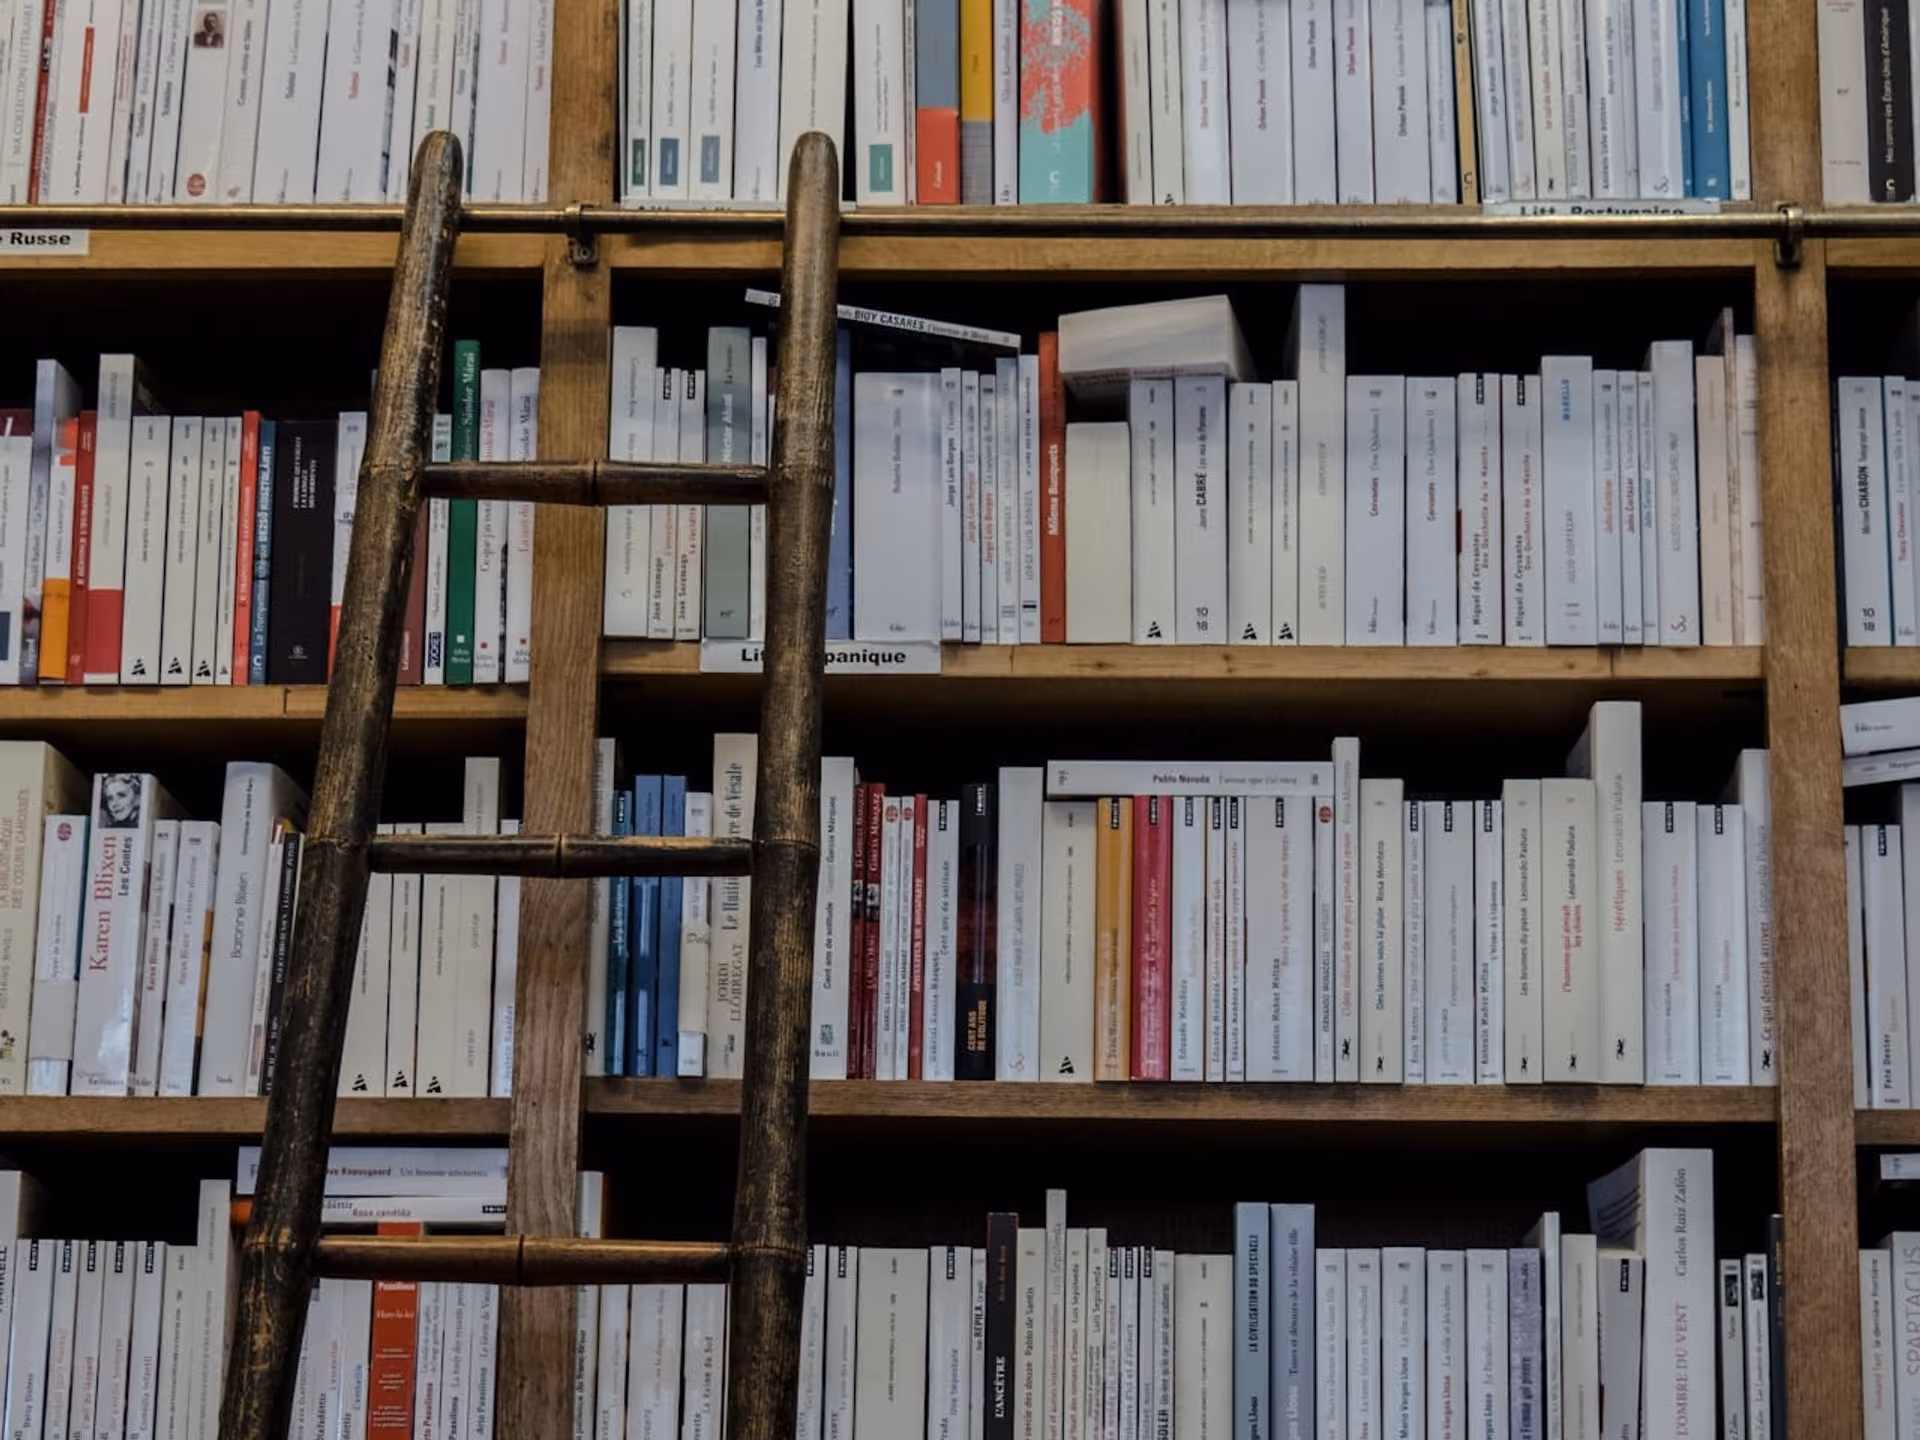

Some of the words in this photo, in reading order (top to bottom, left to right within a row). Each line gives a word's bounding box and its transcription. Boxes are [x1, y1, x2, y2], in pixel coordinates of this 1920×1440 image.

[10, 231, 71, 246] Russe
[1049, 444, 1059, 494] Busquets
[1858, 466, 1870, 508] CHABON
[1049, 497, 1059, 535] Milena
[825, 648, 906, 666] panique
[93, 836, 116, 900] Blixen
[119, 836, 133, 874] Contes
[117, 877, 131, 896] Les
[721, 876, 740, 911] Huiti
[1613, 869, 1625, 931] Hérétiques
[88, 910, 112, 972] Karen
[230, 907, 246, 959] Baronne
[721, 914, 739, 930] Le
[717, 963, 729, 1002] JORDI
[1674, 1237, 1688, 1276] Carlos
[1675, 1302, 1688, 1344] VENT
[1675, 1347, 1689, 1369] DU
[994, 1356, 1005, 1417] L'ANCÊTRE
[1675, 1373, 1689, 1436] L'OMBRE
